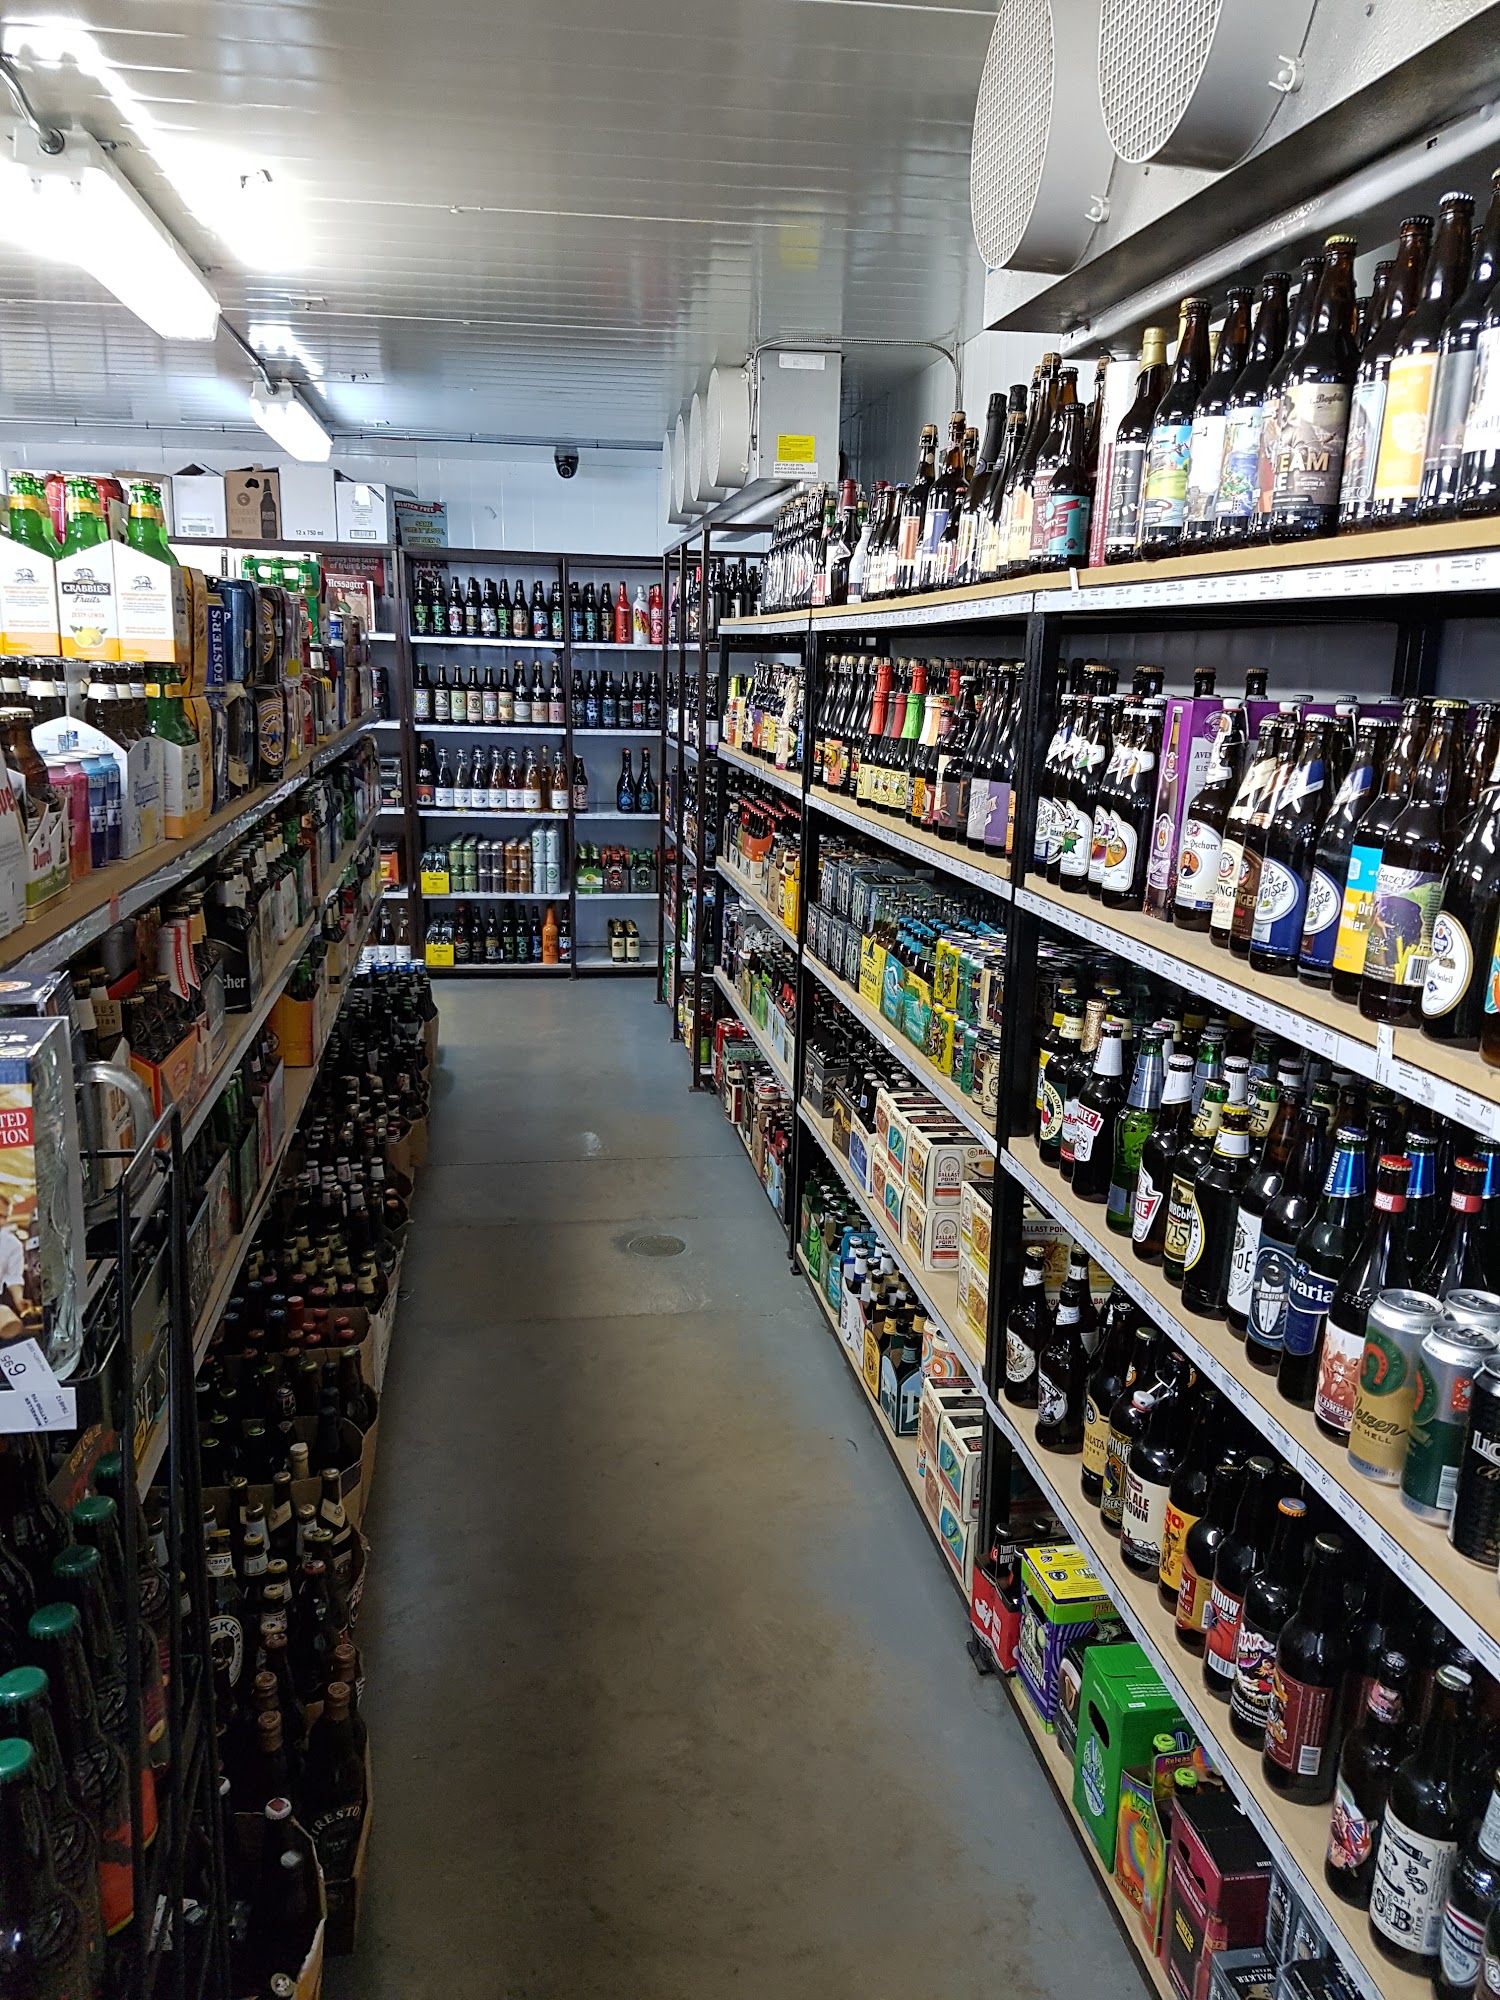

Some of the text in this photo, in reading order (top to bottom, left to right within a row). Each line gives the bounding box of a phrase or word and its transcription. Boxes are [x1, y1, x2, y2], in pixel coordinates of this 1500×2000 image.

[63, 583, 109, 594] CRABBIE'S
[73, 594, 101, 604] Fruits
[212, 609, 224, 683] FOSTER'S
[1436, 972, 1452, 984] Soleil
[1046, 1084, 1062, 1116] TAYLOR'S
[0, 1112, 27, 1127] TED
[1324, 1151, 1340, 1192] Bavaria
[24, 1397, 42, 1426] MIKKELLER
[35, 1402, 48, 1424] TATTOO
[1364, 1430, 1392, 1444] HELL
[1133, 1494, 1150, 1512] ALE
[210, 1622, 241, 1644] SKER
[312, 1806, 360, 1840] IRESTO
[1235, 1973, 1276, 1983] WALKER
